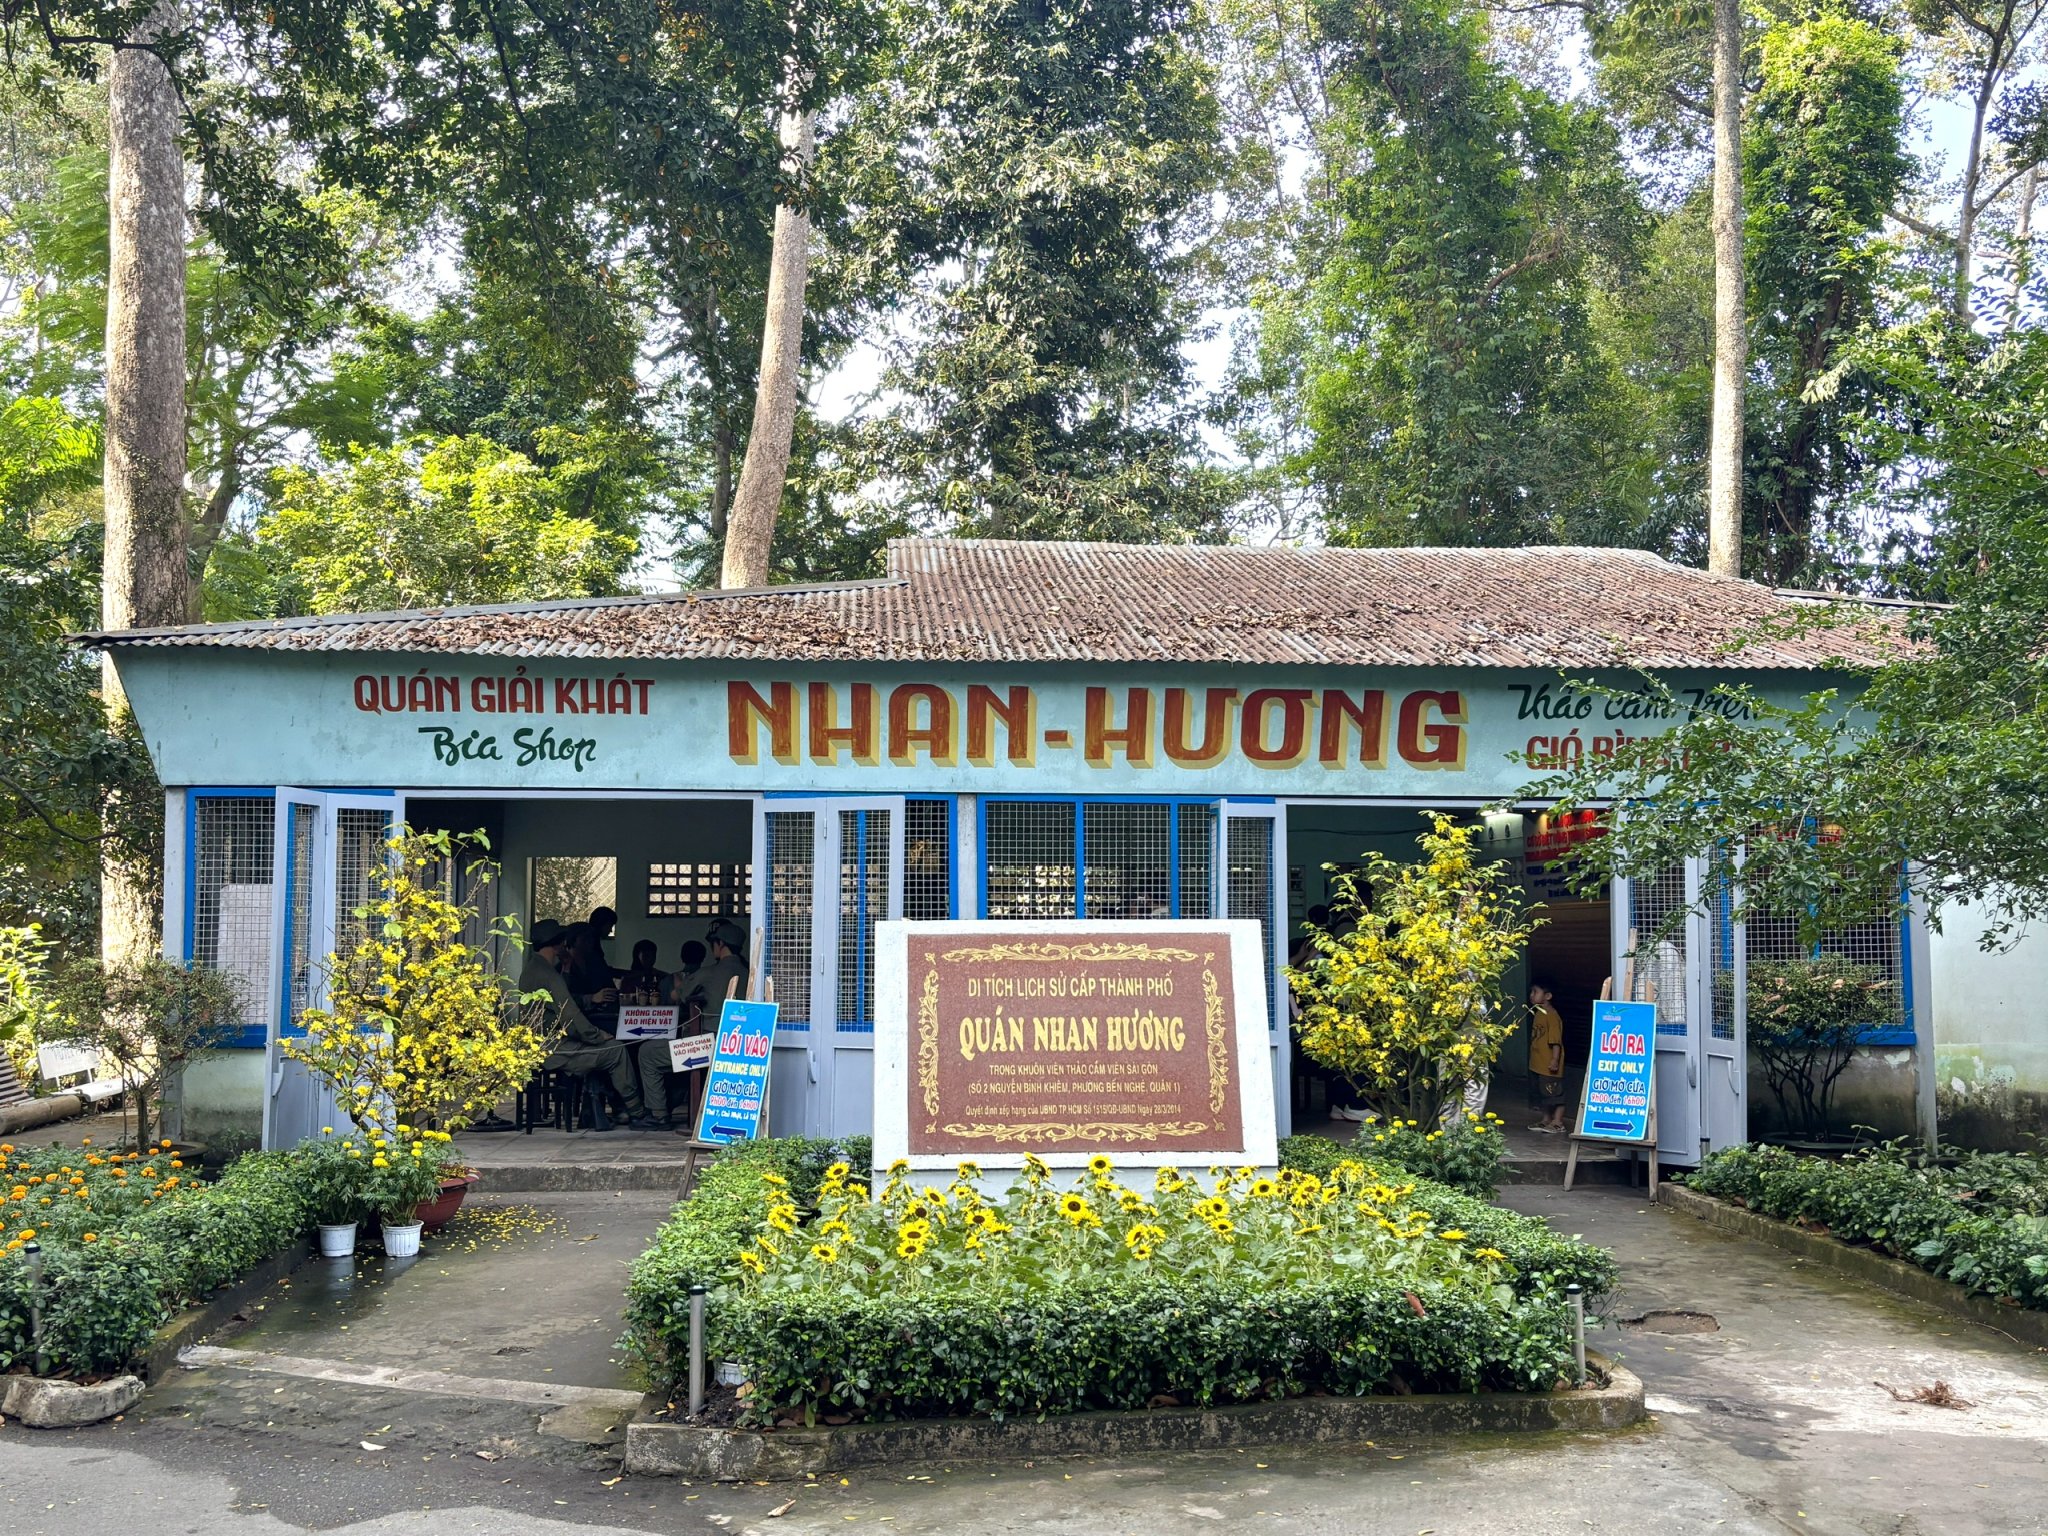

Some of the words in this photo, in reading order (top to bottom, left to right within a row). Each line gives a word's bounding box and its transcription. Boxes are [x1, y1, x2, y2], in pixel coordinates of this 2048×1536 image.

[354, 668, 461, 716] QUÁN
[471, 665, 544, 714] GIẢI
[555, 672, 655, 715] KHÁT
[1508, 683, 1592, 720] Thảo
[728, 681, 1468, 771] NHAN-HƯƠNG
[418, 726, 502, 766] Bia
[513, 726, 596, 772] Shop
[1526, 728, 1583, 771] GIÓ
[968, 977, 980, 996] DI
[984, 973, 1013, 997] TÍCH
[1017, 977, 1045, 1000] LỊCH
[1049, 970, 1066, 997] SỬ
[1070, 970, 1096, 997] CẤP
[1099, 972, 1142, 996] THÀNH
[1146, 970, 1173, 996] PHỐ
[625, 1009, 650, 1017] KHÔNG
[652, 1009, 673, 1018] CHẠM
[640, 1018, 657, 1026] HIỆN
[660, 1018, 672, 1026] VẬT
[720, 1025, 742, 1055] LỐI
[745, 1030, 769, 1058] VÀO
[959, 1005, 1024, 1061] QUÁN
[1033, 1017, 1097, 1052] NHAN
[1106, 1008, 1185, 1052] HƯƠNG
[1601, 1025, 1624, 1054] LỐI
[1626, 1034, 1645, 1056] RA
[673, 1041, 693, 1049] KHÔNG
[695, 1038, 711, 1046] CHẠM
[702, 1044, 712, 1052] VẬT
[714, 1060, 749, 1076] ENTRANCE
[749, 1064, 766, 1077] ONLY
[989, 1064, 1015, 1075] TRONG
[1018, 1062, 1045, 1075] KHUÔN
[1046, 1062, 1064, 1075] VIÊN
[1066, 1061, 1087, 1075] THẢO
[1107, 1062, 1125, 1075] VIÊN
[1126, 1062, 1140, 1075] SÀI
[1141, 1062, 1158, 1075] GÒN
[1598, 1060, 1618, 1072] EXIT
[1620, 1061, 1644, 1074] ONLY
[713, 1079, 728, 1093] GIỜ
[728, 1079, 744, 1096] MỞ
[743, 1081, 759, 1097] CỬA
[983, 1083, 988, 1093] 2
[990, 1078, 1022, 1094] NGUYỄN
[1106, 1078, 1122, 1093] BẾN
[1150, 1079, 1171, 1095] QUẬN
[1593, 1077, 1610, 1091] GIỜ
[1610, 1077, 1626, 1092] MỞ
[1626, 1077, 1646, 1094] CỬA
[709, 1095, 727, 1107] 9h00
[1591, 1092, 1609, 1103] 9h00
[1609, 1094, 1622, 1104] đến
[1623, 1095, 1645, 1107] 16h00
[965, 1104, 983, 1117] Quyết
[1040, 1104, 1057, 1115] UBND
